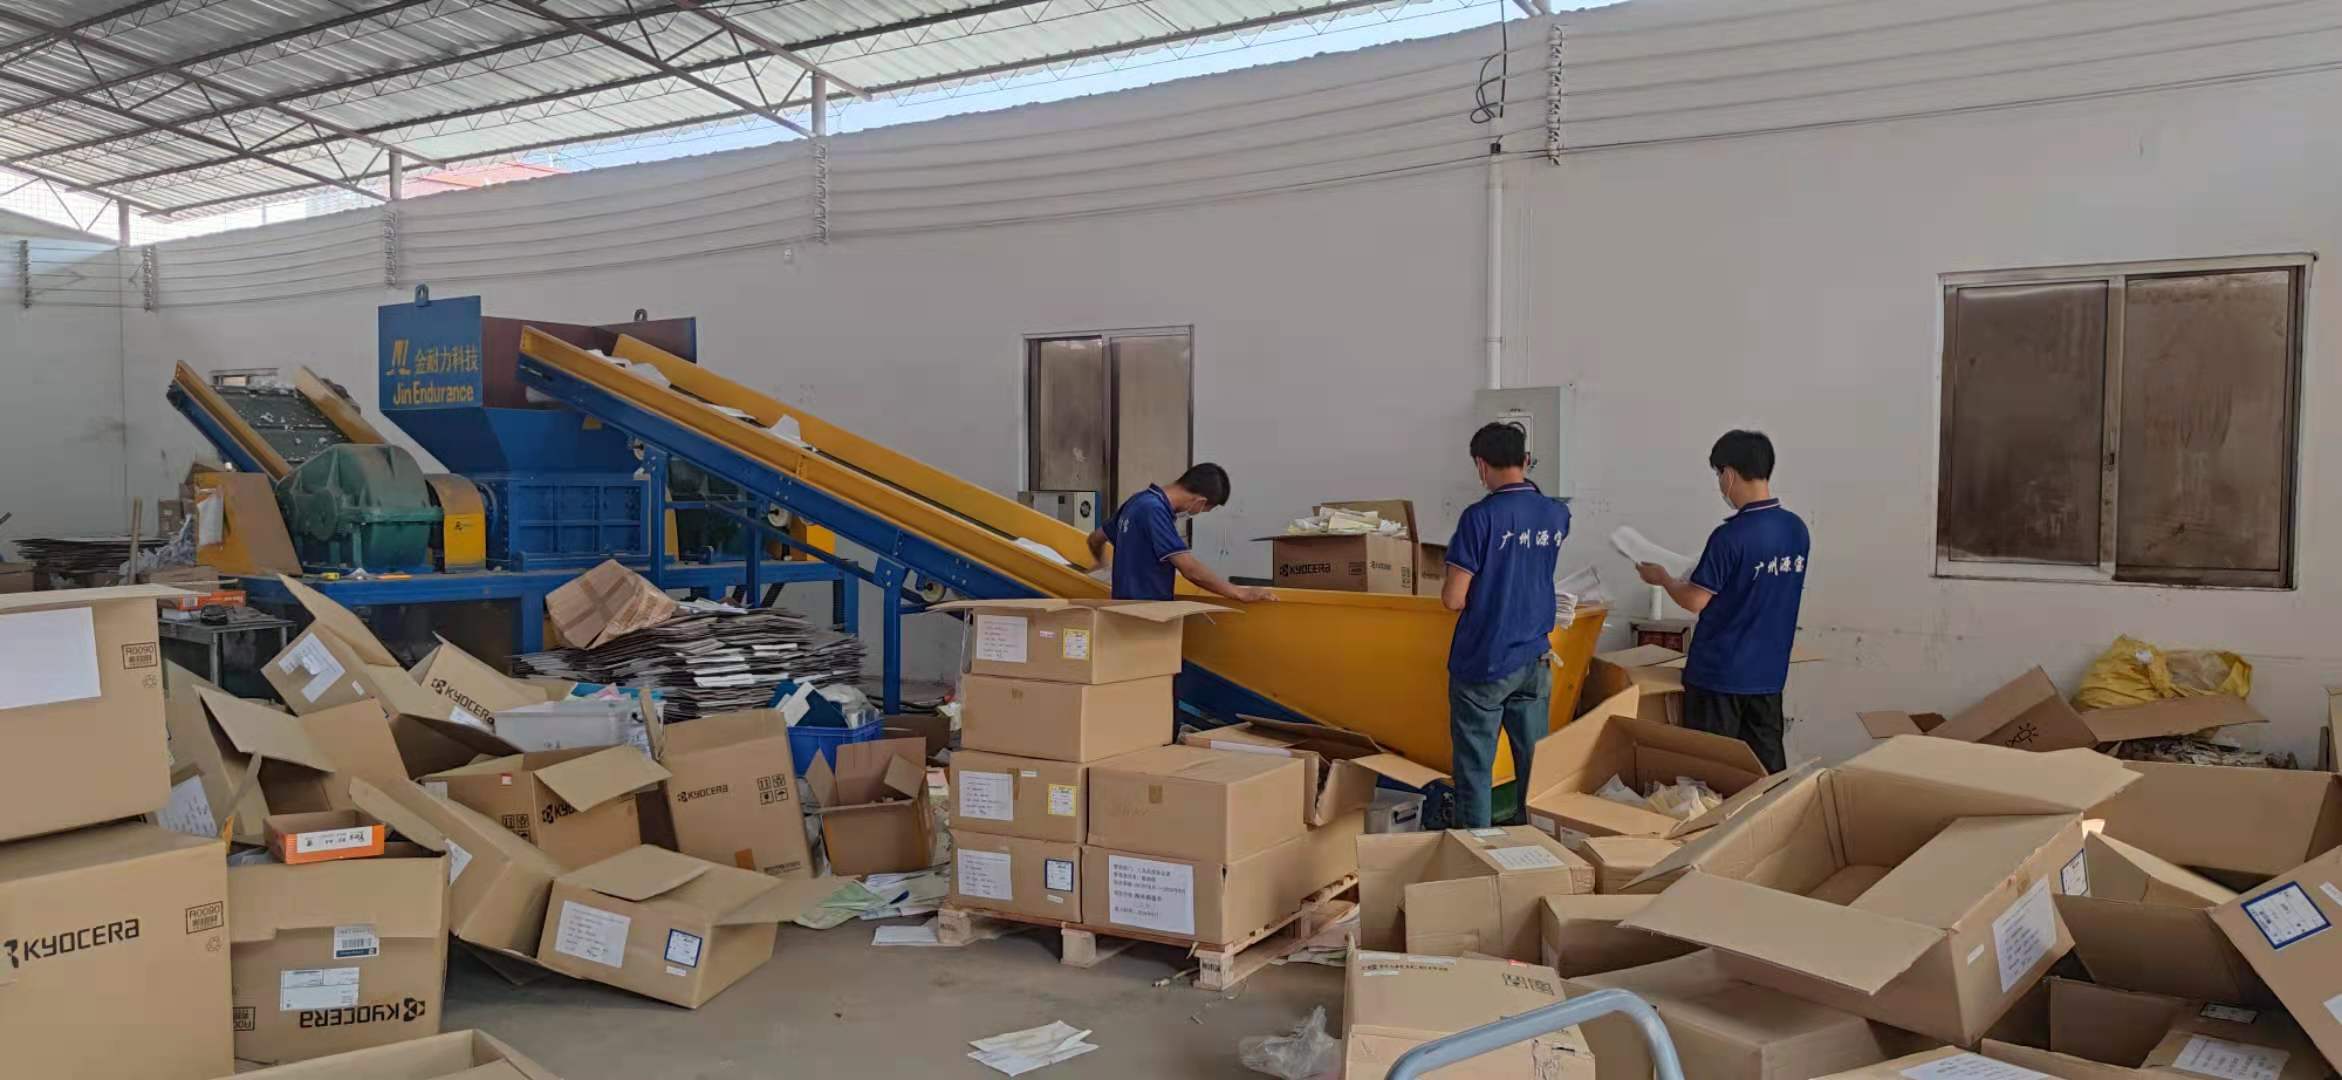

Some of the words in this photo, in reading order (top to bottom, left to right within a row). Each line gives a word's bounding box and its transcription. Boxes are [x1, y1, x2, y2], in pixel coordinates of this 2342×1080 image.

[415, 345, 480, 373] 金耐力科技
[393, 382, 412, 404] Jin
[413, 381, 474, 403] Endurance
[24, 918, 140, 961] KYOCERA
[300, 1003, 400, 1029] KYOCERA
